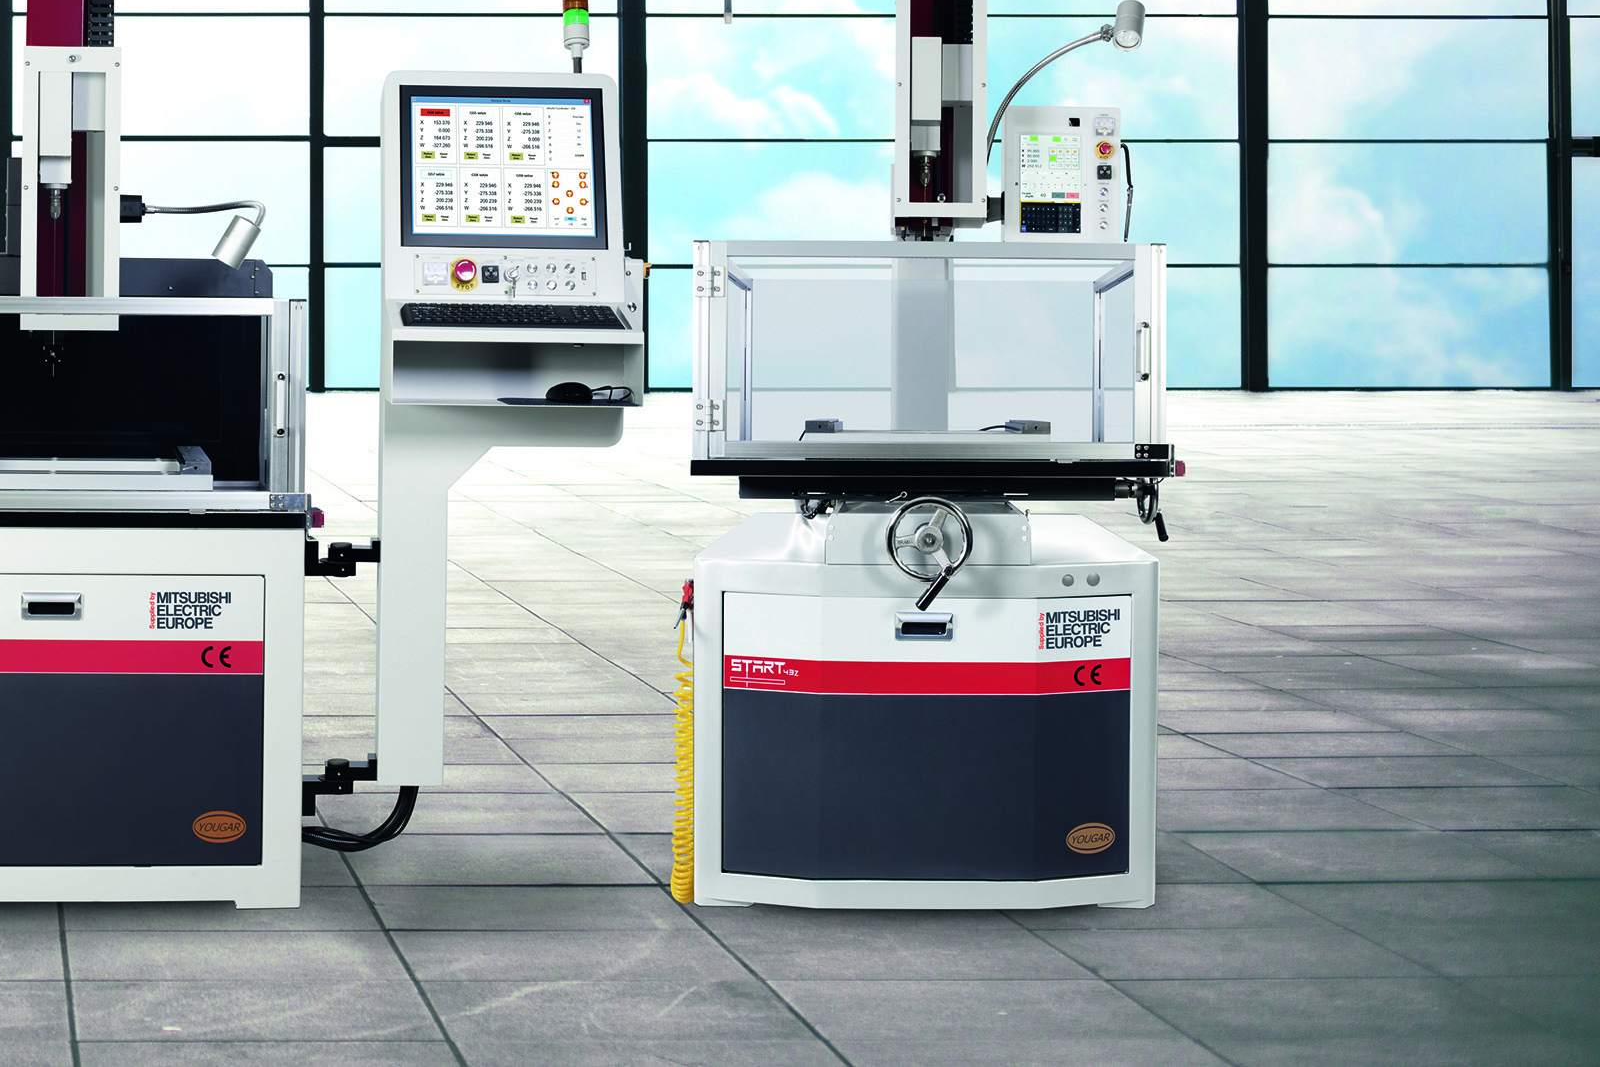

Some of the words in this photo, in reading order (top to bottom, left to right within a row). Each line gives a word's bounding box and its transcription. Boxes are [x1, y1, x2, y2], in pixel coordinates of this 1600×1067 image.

[149, 592, 156, 600] by
[157, 592, 231, 604] MITSUBISHI
[157, 604, 222, 616] ELECTRIC
[1039, 613, 1045, 621] by
[1046, 609, 1120, 624] MITSUBISHI
[157, 617, 213, 629] EUROPE
[1046, 622, 1110, 636] ELECTRIC
[1046, 635, 1102, 649] EUROPE
[201, 646, 232, 668] CE
[1074, 664, 1102, 686] CE
[199, 822, 241, 832] YOUGAR
[1071, 832, 1111, 844] YOUGAR
